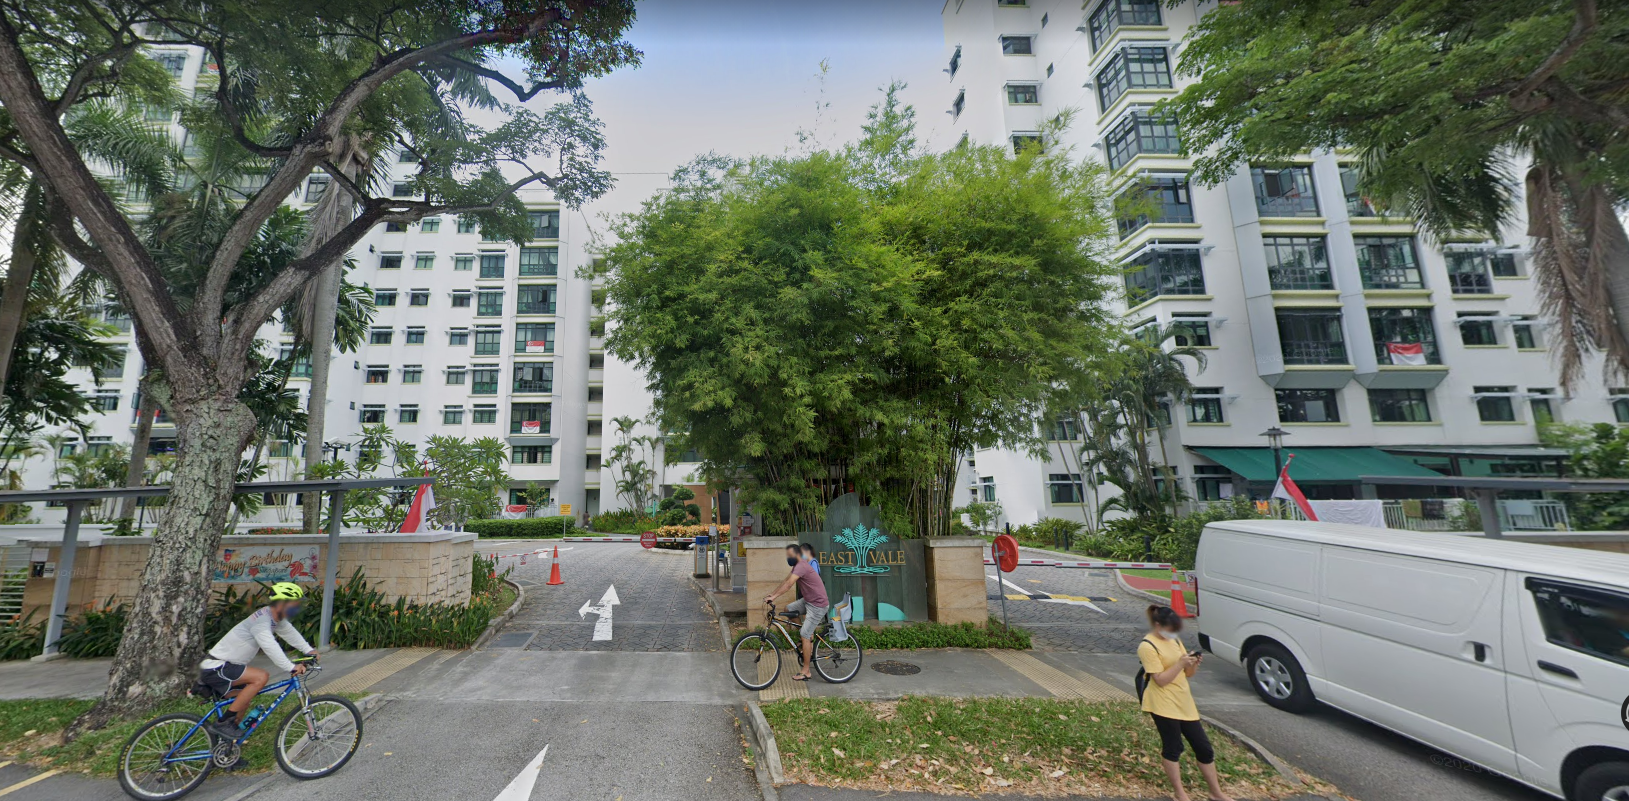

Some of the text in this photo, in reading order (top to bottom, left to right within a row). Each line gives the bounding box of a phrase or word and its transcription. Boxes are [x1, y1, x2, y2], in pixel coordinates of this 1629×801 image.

[213, 548, 293, 577] Happy Birthday
[819, 550, 906, 565] EAST VALE
[258, 691, 287, 722] KLEIN
